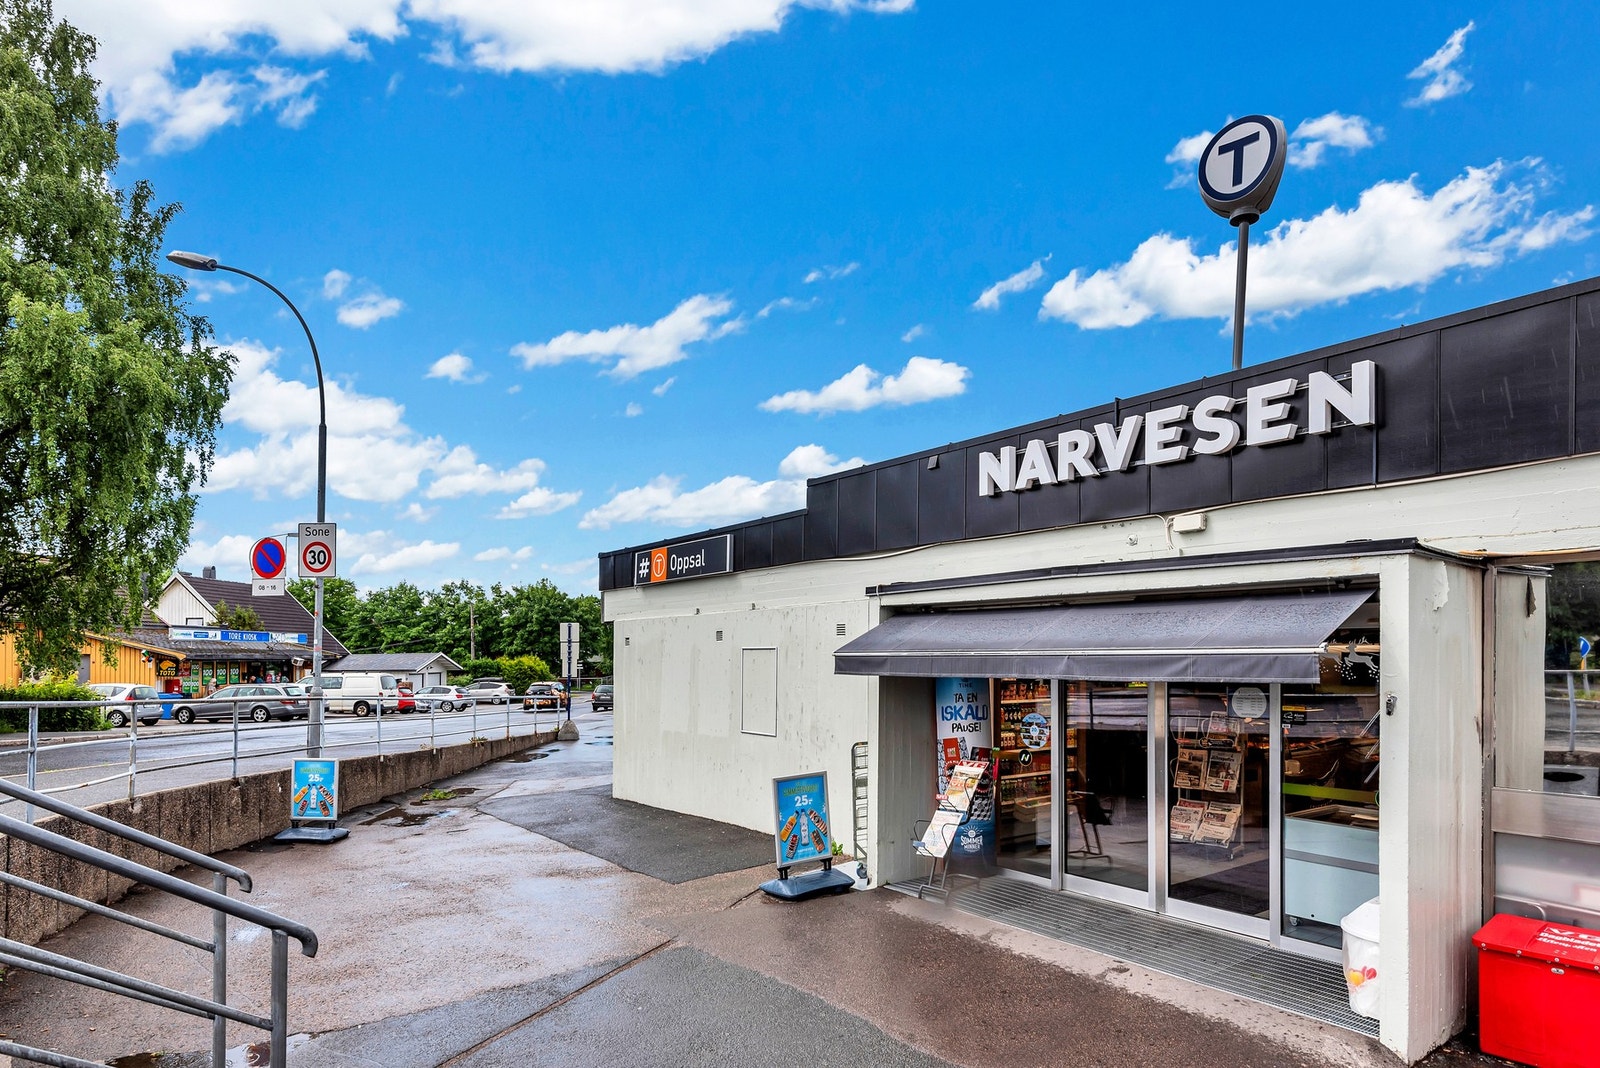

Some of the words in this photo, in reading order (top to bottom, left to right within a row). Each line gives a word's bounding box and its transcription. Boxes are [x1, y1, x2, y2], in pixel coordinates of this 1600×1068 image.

[1218, 131, 1260, 187] T
[979, 359, 1375, 497] NARVESEN
[305, 526, 330, 537] Sone
[308, 549, 327, 565] 30
[670, 548, 705, 575] Oppsal
[228, 632, 241, 640] TORE
[243, 633, 258, 641] KIOSK
[953, 692, 964, 703] TA
[967, 692, 978, 703] EN
[941, 704, 989, 721] ISKALD
